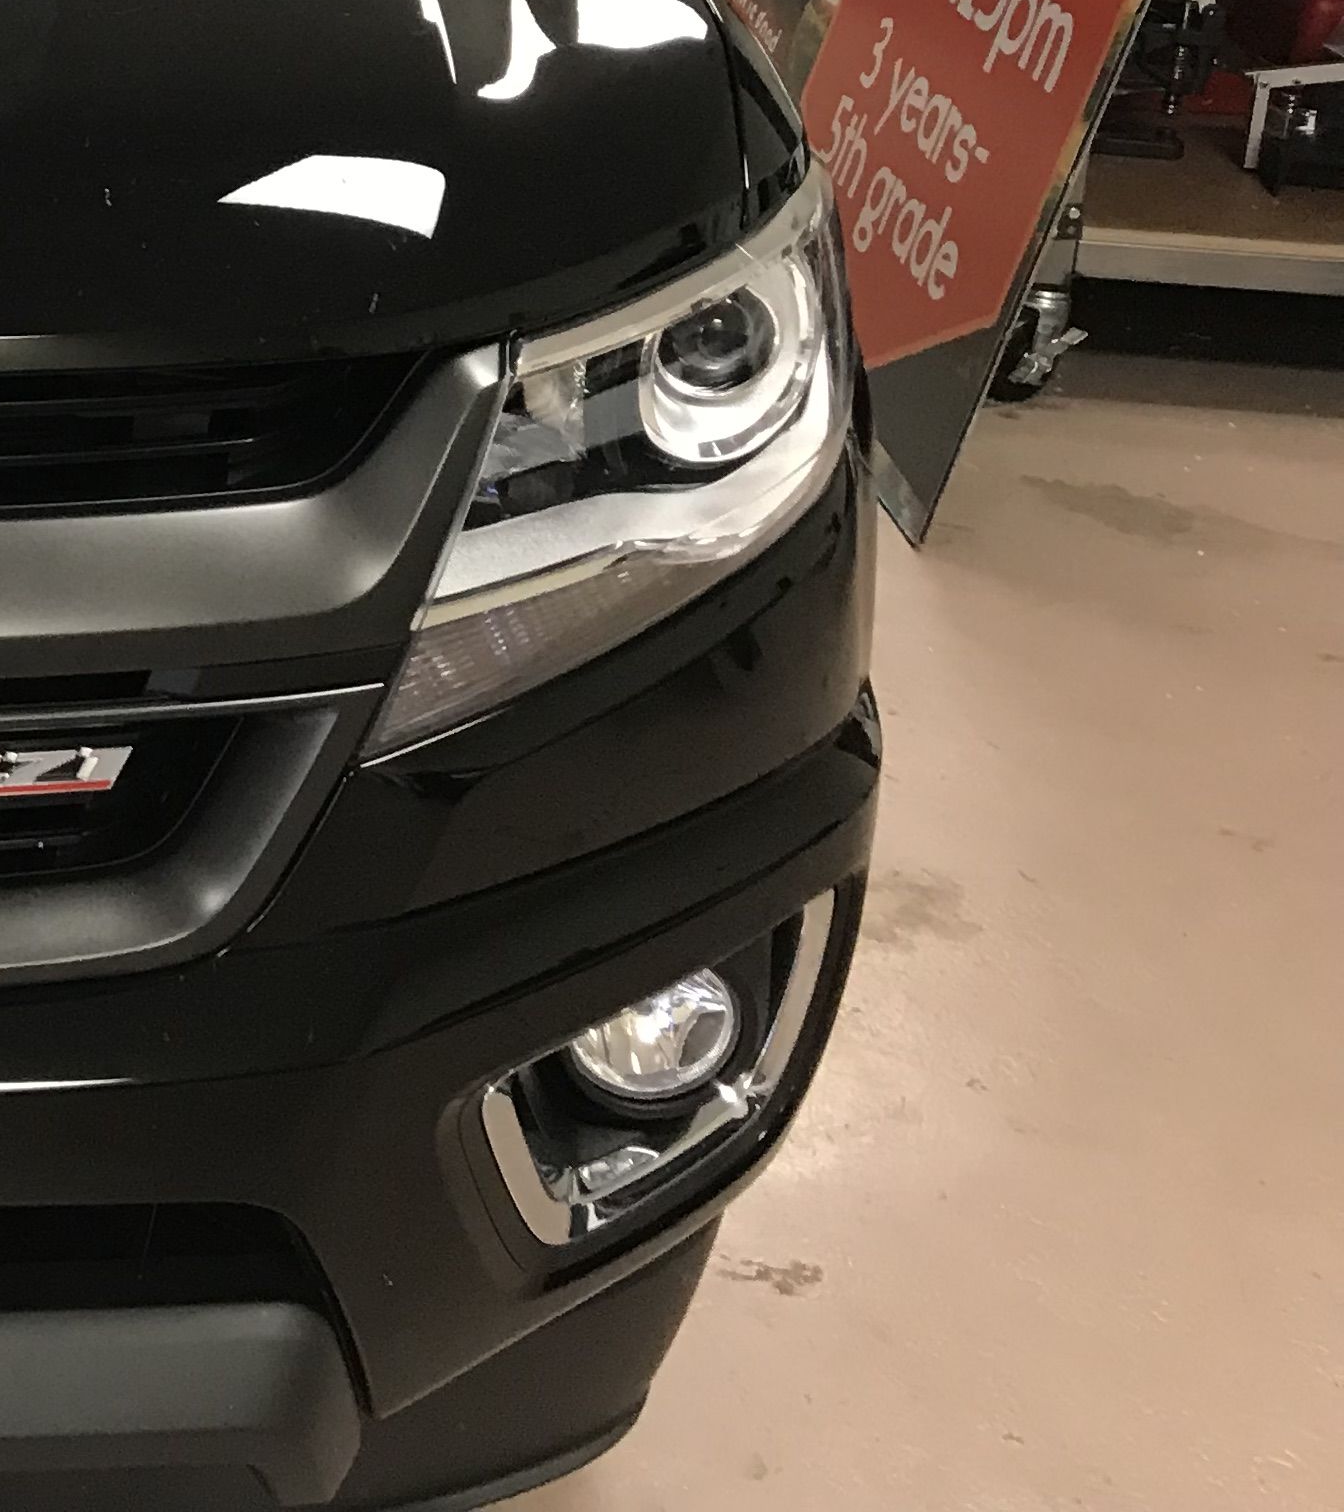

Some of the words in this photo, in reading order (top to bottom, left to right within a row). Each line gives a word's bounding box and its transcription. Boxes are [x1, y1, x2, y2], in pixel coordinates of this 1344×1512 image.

[859, 17, 895, 89] 3
[873, 56, 990, 184] years-
[820, 95, 869, 196] 5th
[852, 165, 961, 301] grade
